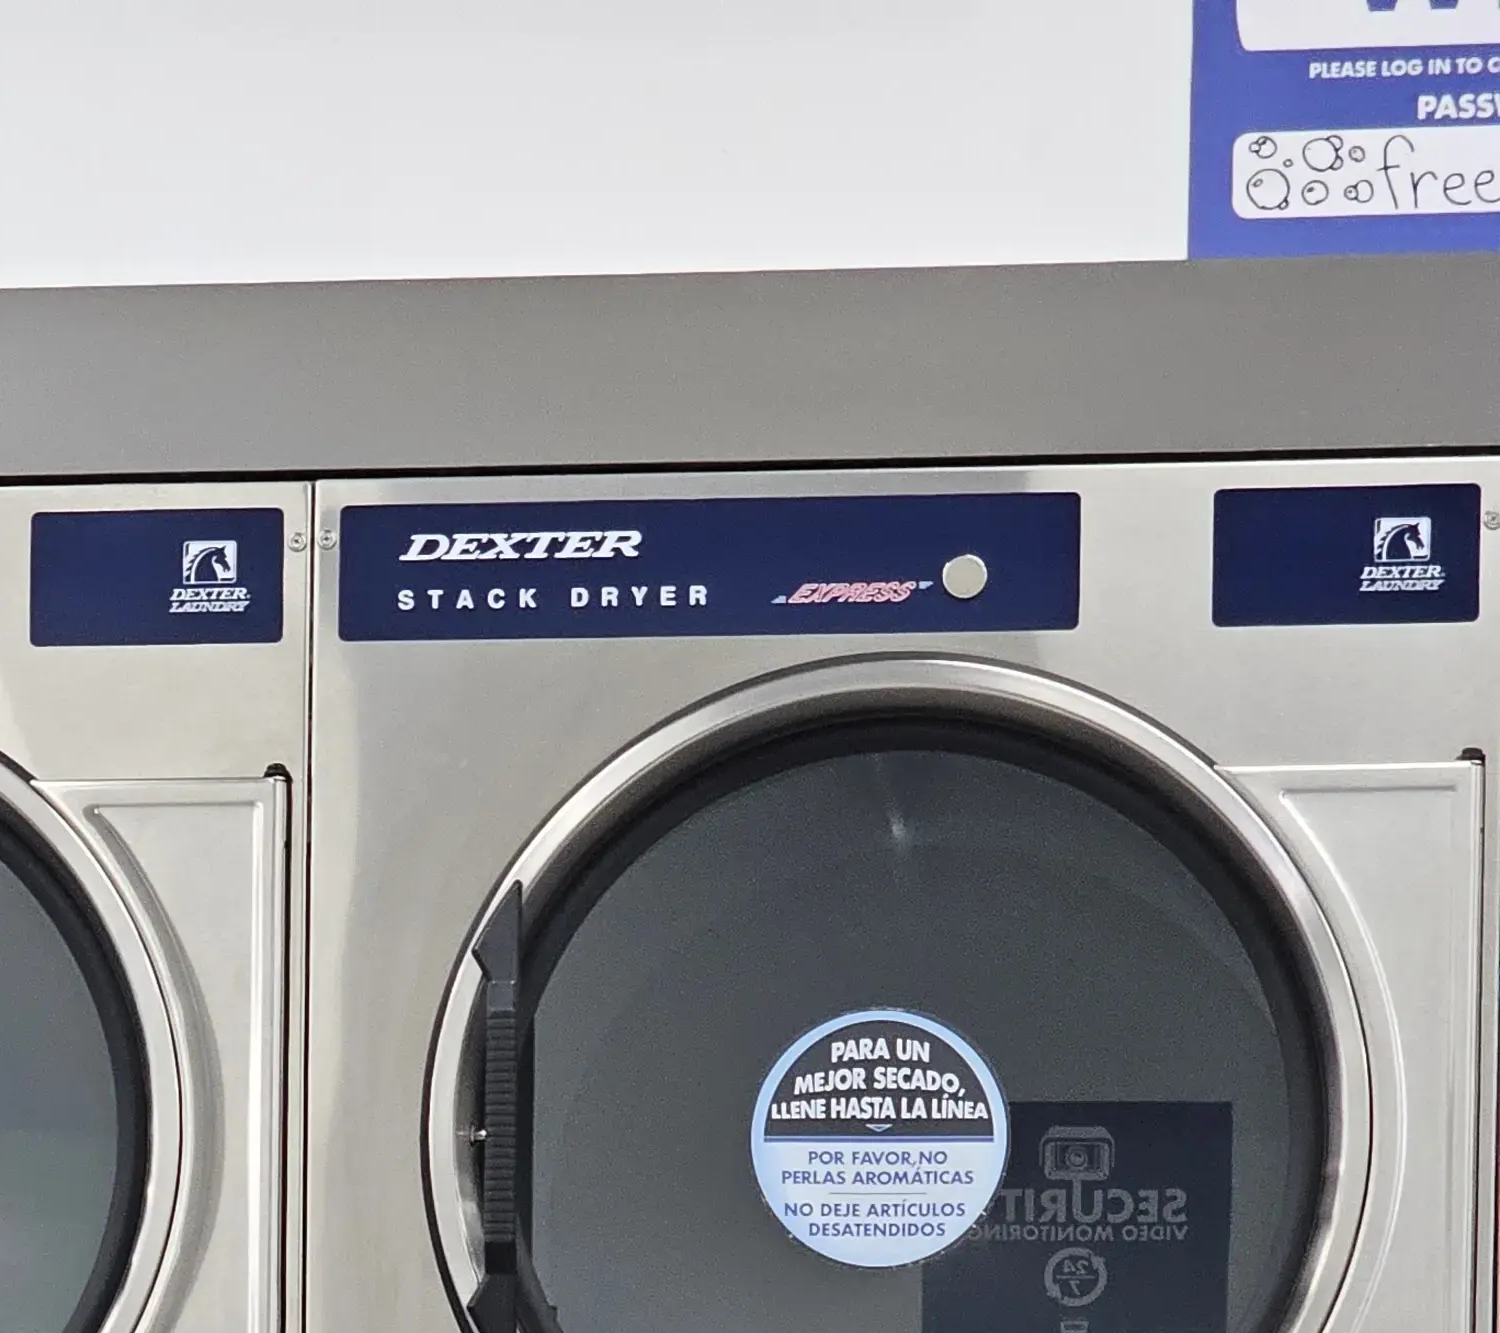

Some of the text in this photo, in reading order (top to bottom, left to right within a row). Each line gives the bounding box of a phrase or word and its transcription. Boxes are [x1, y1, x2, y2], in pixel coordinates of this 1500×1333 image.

[1309, 57, 1483, 79] PLEASE LOG IN TO
[1417, 92, 1500, 120] PASS
[399, 530, 643, 561] DEXTER
[1359, 565, 1444, 579] DEXTER
[169, 587, 249, 601] DEXTER
[787, 581, 916, 604] EXPRESS
[1359, 579, 1445, 592] LAUNDRY
[168, 601, 250, 613] LAUNDRY
[398, 585, 708, 611] STACK DRYER
[831, 1038, 930, 1064] PARA UN
[793, 1066, 966, 1098] MEJOR SECADO,
[771, 1094, 989, 1120] LLENE HASTA LA LÍNEA
[808, 1151, 844, 1165] POR
[919, 1151, 948, 1165] NO
[782, 1167, 974, 1185] PERLAS AROMÁTICAS
[784, 1198, 966, 1217] NO DEJE ARTÍCULOS
[808, 1223, 946, 1237] DESATENDIDOS
